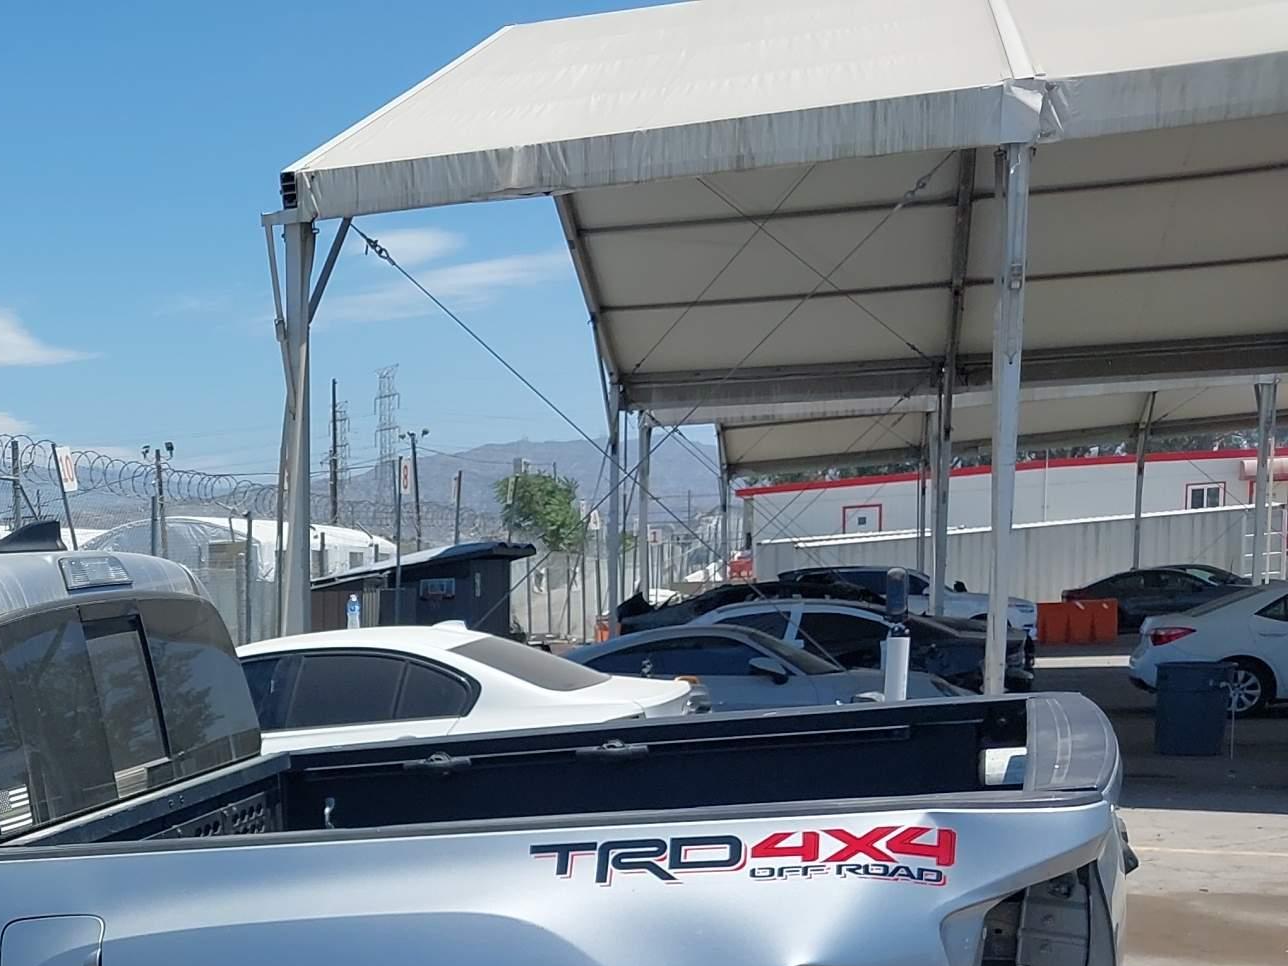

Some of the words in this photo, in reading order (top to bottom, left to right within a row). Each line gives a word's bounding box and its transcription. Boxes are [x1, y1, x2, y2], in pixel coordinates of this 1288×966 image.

[59, 455, 74, 483] 10
[402, 464, 409, 490] 8
[650, 531, 658, 543] 1
[529, 835, 747, 887] TRD
[749, 864, 830, 881] OFF
[835, 862, 946, 886] ROAD
